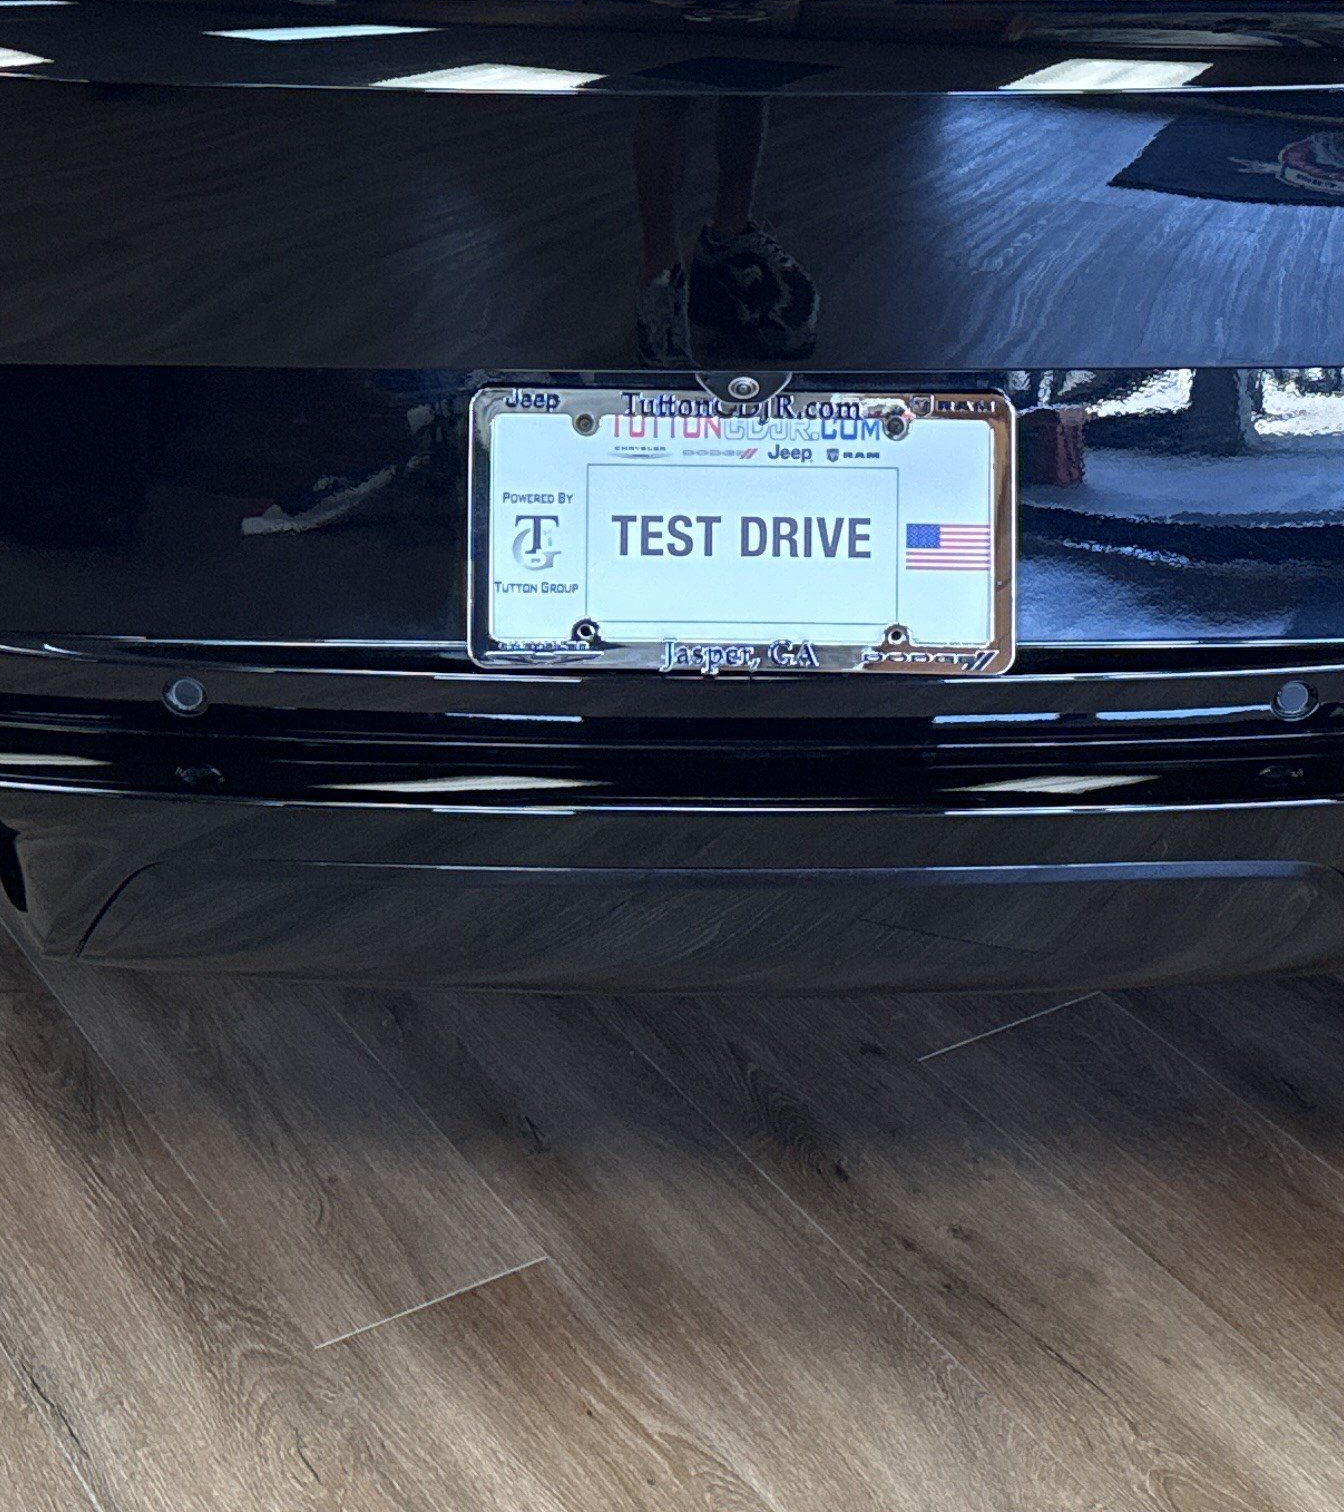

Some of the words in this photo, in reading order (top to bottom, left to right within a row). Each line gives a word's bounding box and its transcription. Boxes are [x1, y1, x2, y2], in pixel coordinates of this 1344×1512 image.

[505, 389, 560, 413] Jeep
[768, 444, 813, 462] Jeep
[843, 451, 880, 459] RAM
[502, 492, 555, 504] POWERED
[611, 515, 722, 557] TEST
[740, 516, 872, 559] DRIVE
[494, 581, 538, 594] TUTTON
[541, 581, 579, 594] GROUP
[659, 638, 761, 675] Jasper,
[767, 640, 820, 668] GA
